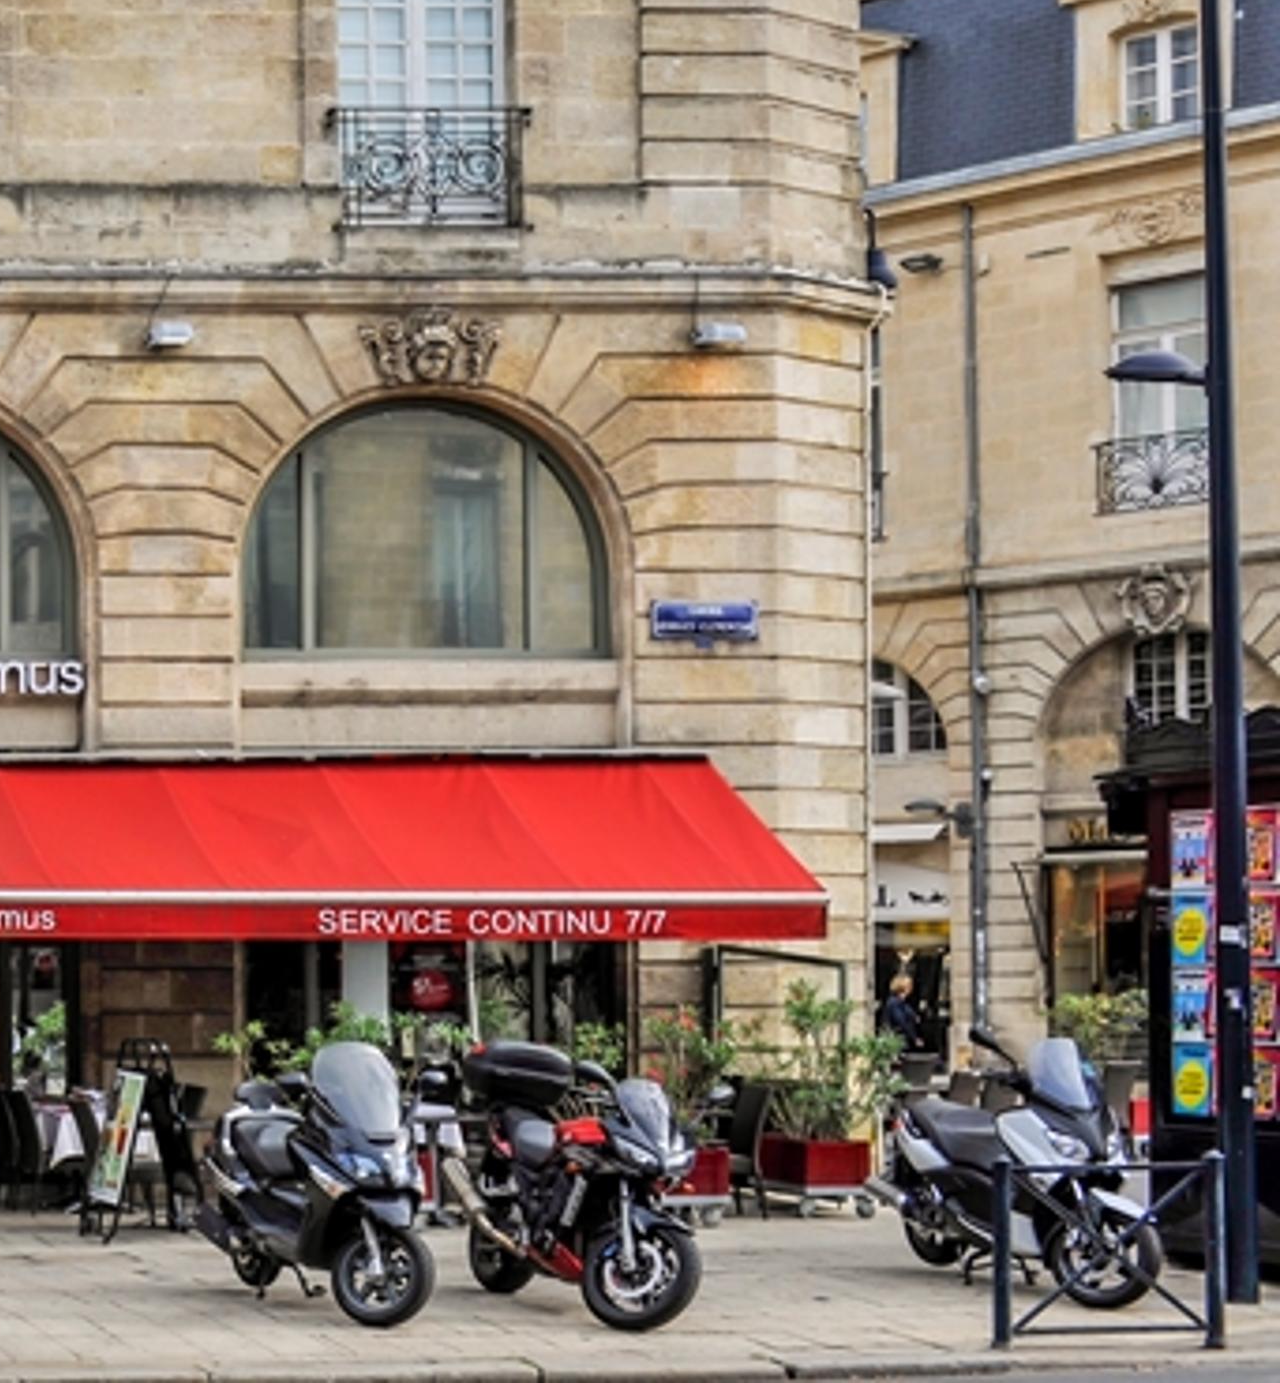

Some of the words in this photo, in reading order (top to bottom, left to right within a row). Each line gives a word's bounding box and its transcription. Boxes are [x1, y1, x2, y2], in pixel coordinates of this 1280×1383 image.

[317, 908, 453, 935] SERVICE
[467, 908, 611, 935] CONTINU
[624, 909, 667, 935] 7/7
